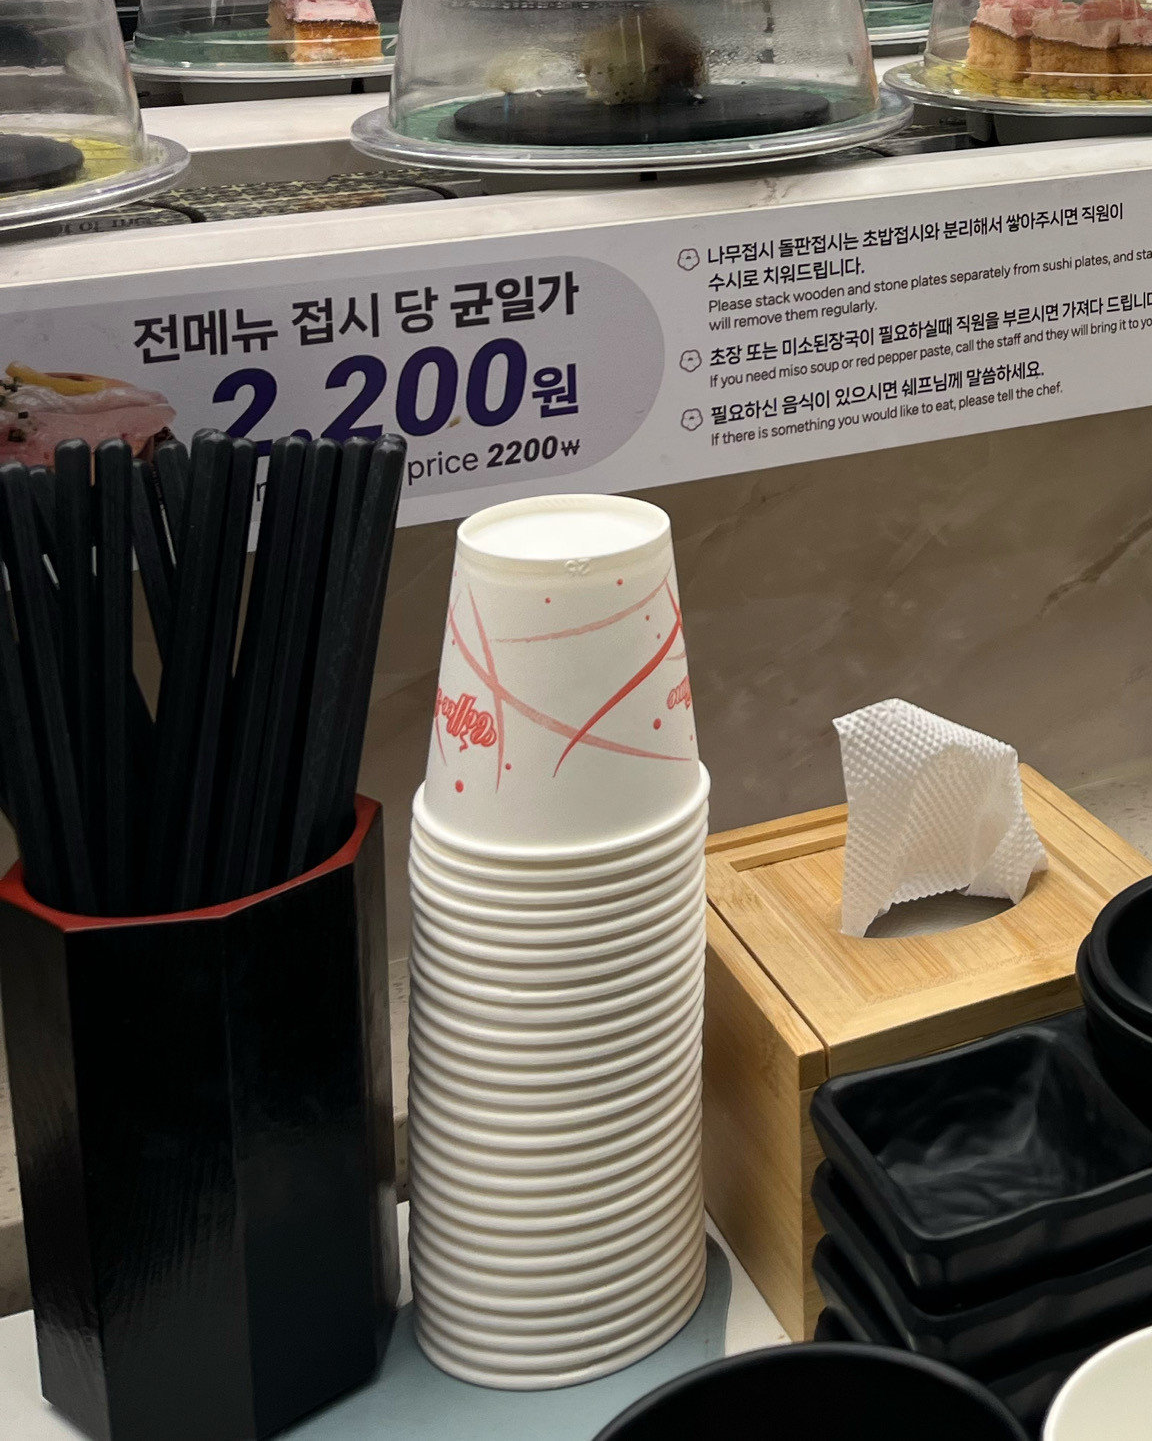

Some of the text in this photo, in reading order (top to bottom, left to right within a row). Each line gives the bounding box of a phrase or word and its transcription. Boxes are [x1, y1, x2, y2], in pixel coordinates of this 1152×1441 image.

[707, 202, 1123, 265] 나무접시 돌판접시는 초밥접시와 분리해서 쌓아주시면 직원이
[708, 256, 865, 292] 수시로 치워드립니다.
[708, 297, 752, 313] Please
[755, 290, 791, 308] stack
[793, 284, 845, 302] wooden
[847, 281, 871, 296] and
[873, 277, 908, 292] stone
[910, 273, 948, 290] plates
[950, 265, 1011, 284] separately
[1013, 262, 1040, 276] from
[1042, 257, 1073, 272] sushi
[1074, 253, 1111, 270] plates,
[1113, 249, 1134, 264] and
[134, 271, 579, 364] 전메뉴 접시 당 균일가
[709, 299, 878, 331] will remove them regularly.
[709, 345, 742, 366] 초장
[746, 342, 778, 362] 또는
[782, 327, 875, 357] 미소된장국이
[878, 316, 953, 345] 필요하실때
[956, 311, 1000, 332] 직원을
[1002, 305, 1059, 328] 부르시면
[1062, 298, 1104, 319] 가져다
[709, 375, 718, 388] If
[720, 370, 743, 389] you
[745, 366, 777, 383] need
[779, 363, 808, 379] miso
[810, 360, 840, 378] soup
[841, 357, 854, 370] or
[855, 353, 875, 368] red
[877, 348, 917, 367] pepper
[919, 342, 954, 360] paste,
[955, 340, 975, 354] call
[976, 337, 995, 351] the
[997, 333, 1022, 347] staff
[1023, 330, 1044, 344] and
[1046, 325, 1070, 342] they
[1071, 323, 1089, 336] will
[1090, 319, 1118, 335] bring
[1119, 318, 1127, 330] it
[1128, 316, 1139, 328] to
[711, 360, 1045, 425] 필요하신 음식이 있으시면 쉐프님께 말씀하세요.
[711, 380, 1063, 446] If there is something you would like to eat, please tell the chef.
[407, 447, 480, 486] price
